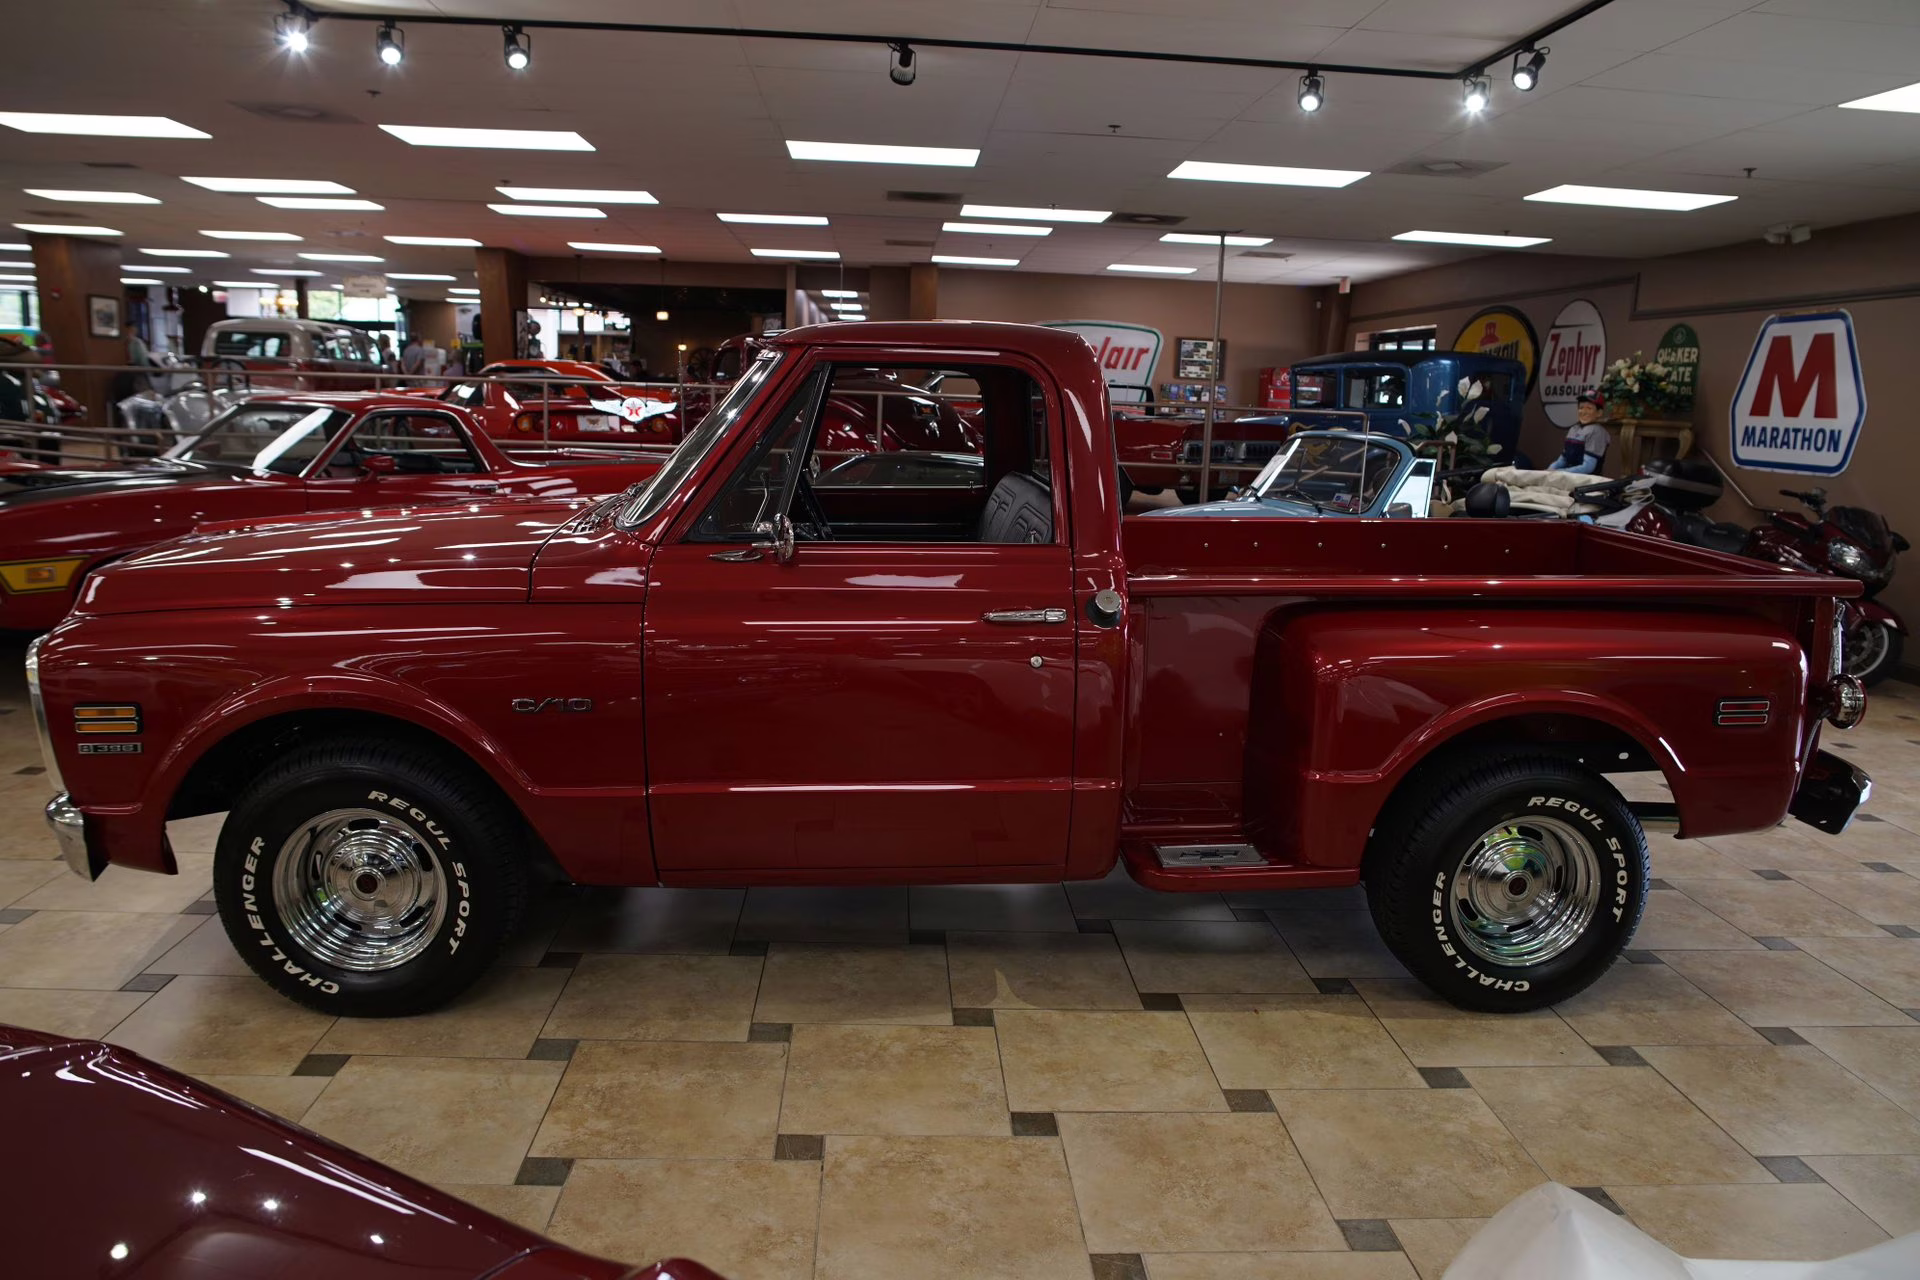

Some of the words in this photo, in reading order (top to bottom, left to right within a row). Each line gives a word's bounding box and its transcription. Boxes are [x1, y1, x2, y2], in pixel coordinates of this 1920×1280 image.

[1545, 331, 1601, 384] Zephyr
[1657, 347, 1699, 363] QUAKER
[1749, 332, 1838, 419] M
[1741, 425, 1842, 453] MARATHON
[512, 698, 592, 712] C/10
[242, 836, 341, 995] CHALLENGER
[367, 790, 451, 851] REGUL
[449, 861, 471, 956] SPORT
[1432, 871, 1531, 992] CHALLENGER
[1527, 796, 1605, 832] REGUL
[1605, 836, 1629, 922] SPORT
